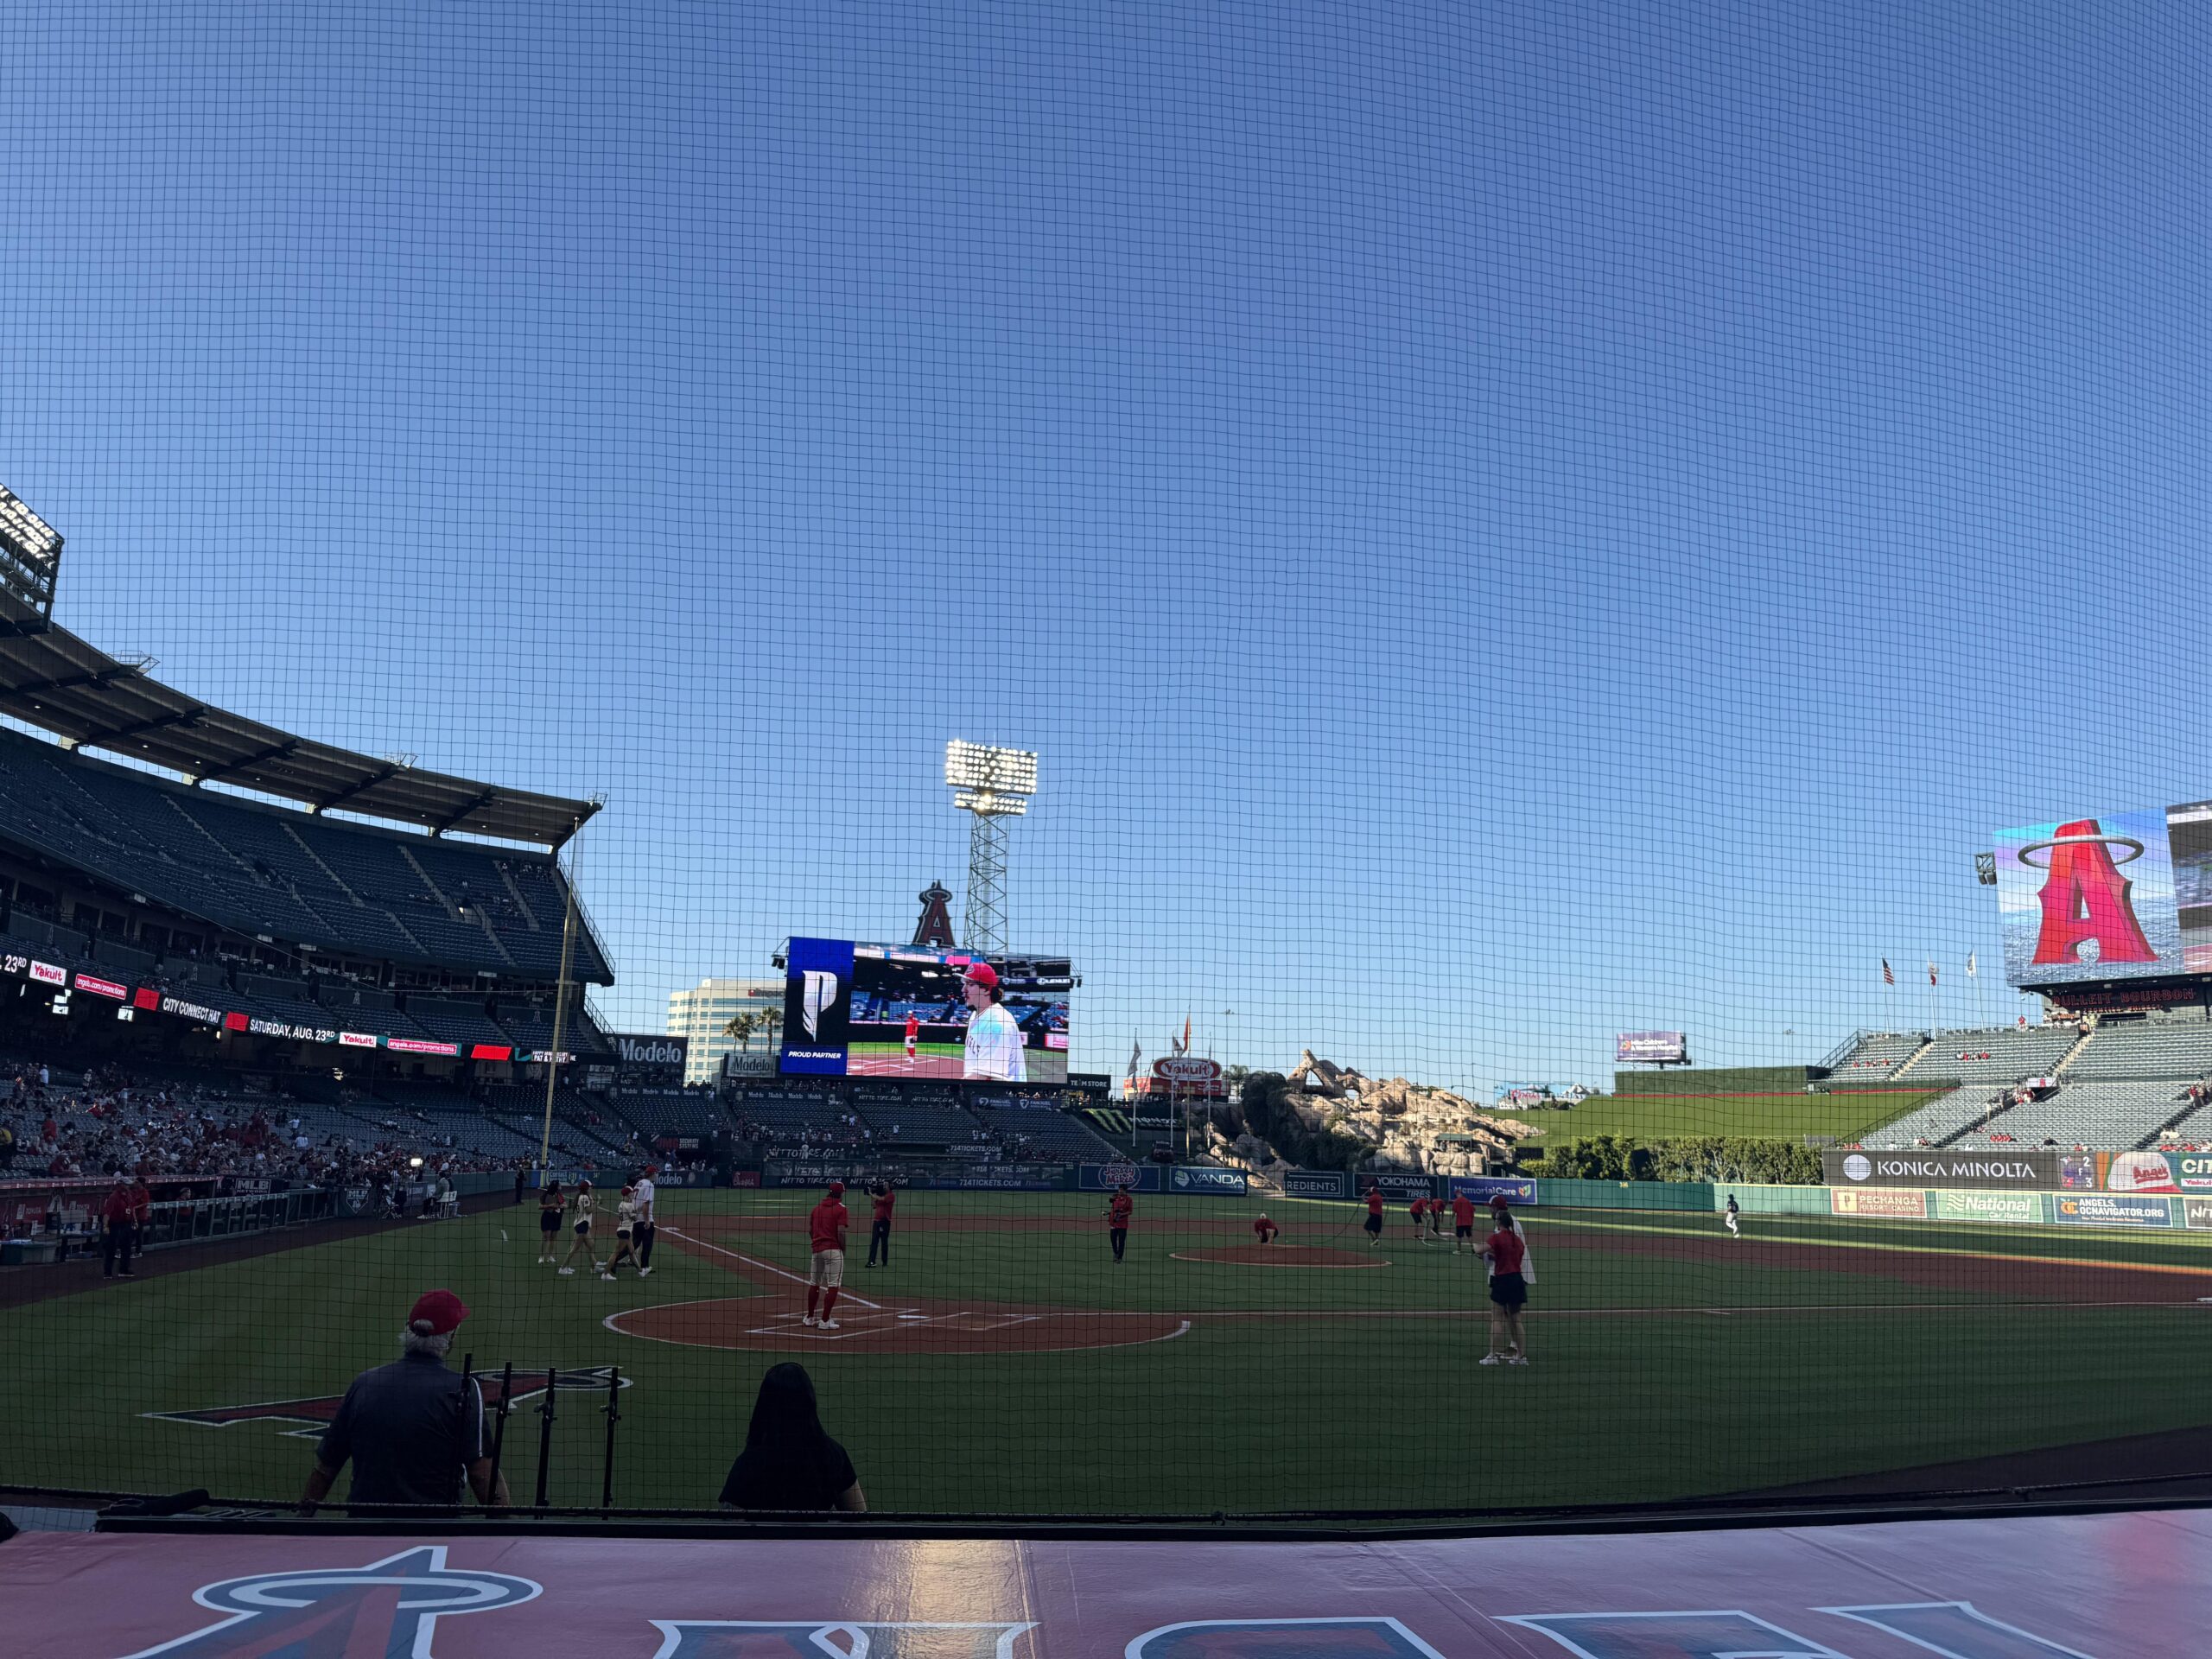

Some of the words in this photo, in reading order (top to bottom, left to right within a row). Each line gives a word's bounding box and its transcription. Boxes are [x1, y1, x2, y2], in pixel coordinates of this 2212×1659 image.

[35, 964, 63, 982] Yakult
[162, 997, 180, 1012] CITY
[179, 1002, 209, 1021] CONNECT
[207, 1009, 221, 1024] HAT
[250, 1020, 291, 1039] SATURDAY,
[292, 1027, 315, 1040] AUG.
[315, 1030, 335, 1041] 23RD
[344, 1035, 373, 1045] Yakult
[389, 1040, 454, 1052] angels.com/promotions
[619, 1039, 683, 1064] Modelo
[734, 1056, 770, 1072] Modelo
[1165, 1064, 1208, 1075] Yakult
[2082, 1156, 2091, 1167] 2
[1878, 1161, 1948, 1176] KONICA
[1952, 1162, 2037, 1178] MINOLTA
[781, 1176, 804, 1185] NITTO
[959, 1178, 1022, 1187] 714TICKETS.COM
[1191, 1173, 1245, 1185] VANDA
[1376, 1176, 1431, 1188] YOKOHAMA
[2085, 1177, 2093, 1188] 3
[237, 1180, 270, 1190] MLB
[1406, 1189, 1431, 1199] TIRES
[1454, 1185, 1516, 1197] MemorialCare
[1859, 1196, 1919, 1206] PECHANGA
[1966, 1196, 2031, 1213] National
[2079, 1198, 2117, 1208] ANGELS.
[2079, 1207, 2164, 1217] OCNAVIGATOR.ORG
